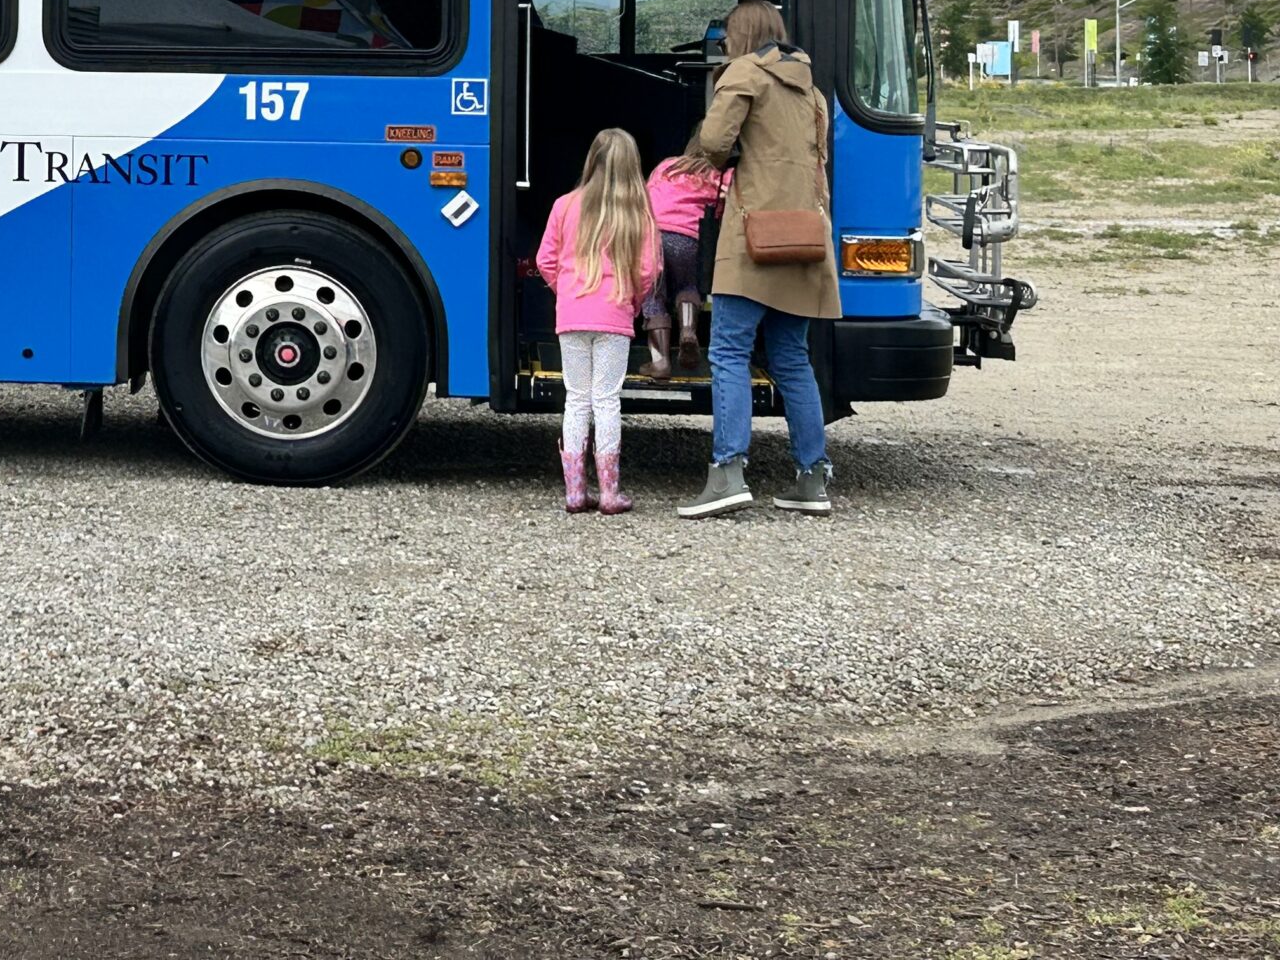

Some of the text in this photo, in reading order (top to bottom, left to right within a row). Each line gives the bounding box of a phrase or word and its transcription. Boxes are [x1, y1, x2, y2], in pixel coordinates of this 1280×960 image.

[239, 81, 310, 122] 157
[389, 128, 433, 139] KNEELING
[0, 140, 209, 186] TRANSIT
